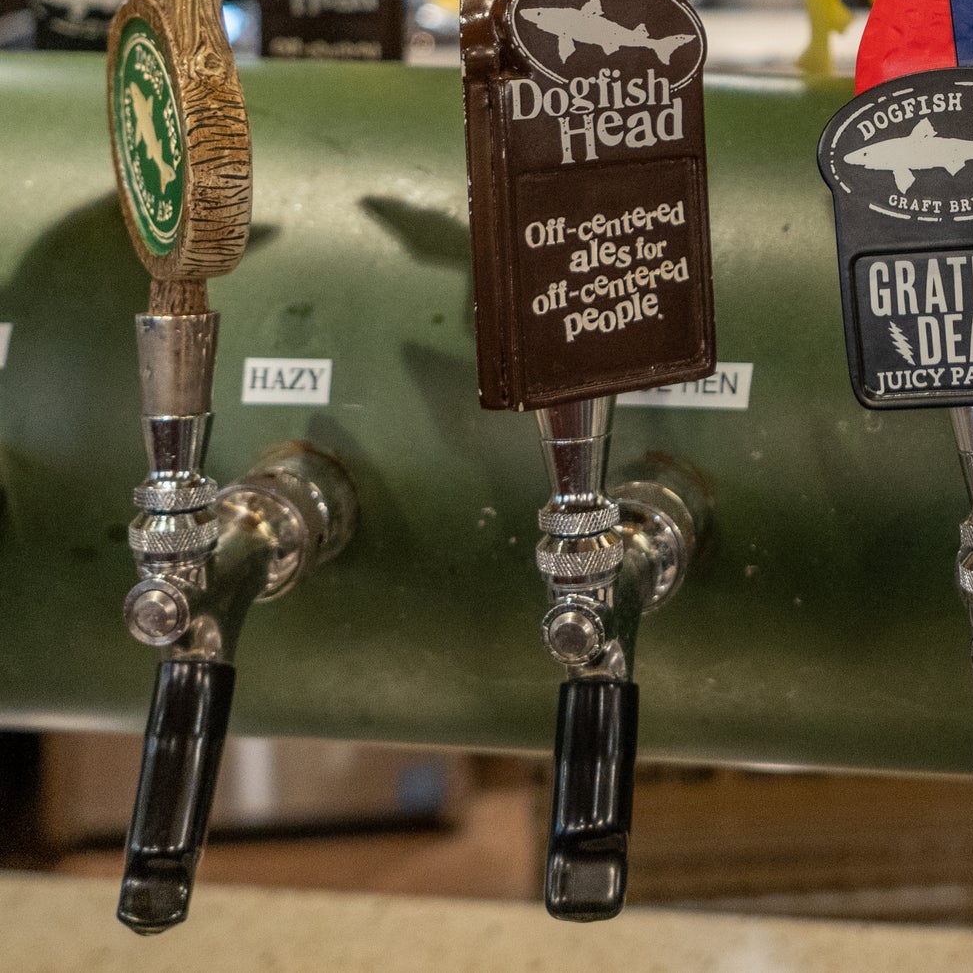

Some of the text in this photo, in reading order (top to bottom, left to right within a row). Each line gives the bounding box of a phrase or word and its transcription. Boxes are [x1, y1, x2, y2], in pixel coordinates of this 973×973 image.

[509, 67, 672, 120] Dogfish
[857, 92, 963, 141] DOGFISH
[558, 97, 685, 164] Head
[525, 200, 685, 248] Off-centered
[888, 194, 943, 213] CRAFT
[569, 236, 667, 273] ales for
[532, 257, 689, 315] off-centered
[563, 292, 664, 343] people.
[249, 366, 326, 390] HAZY
[876, 367, 946, 395] JUICY
